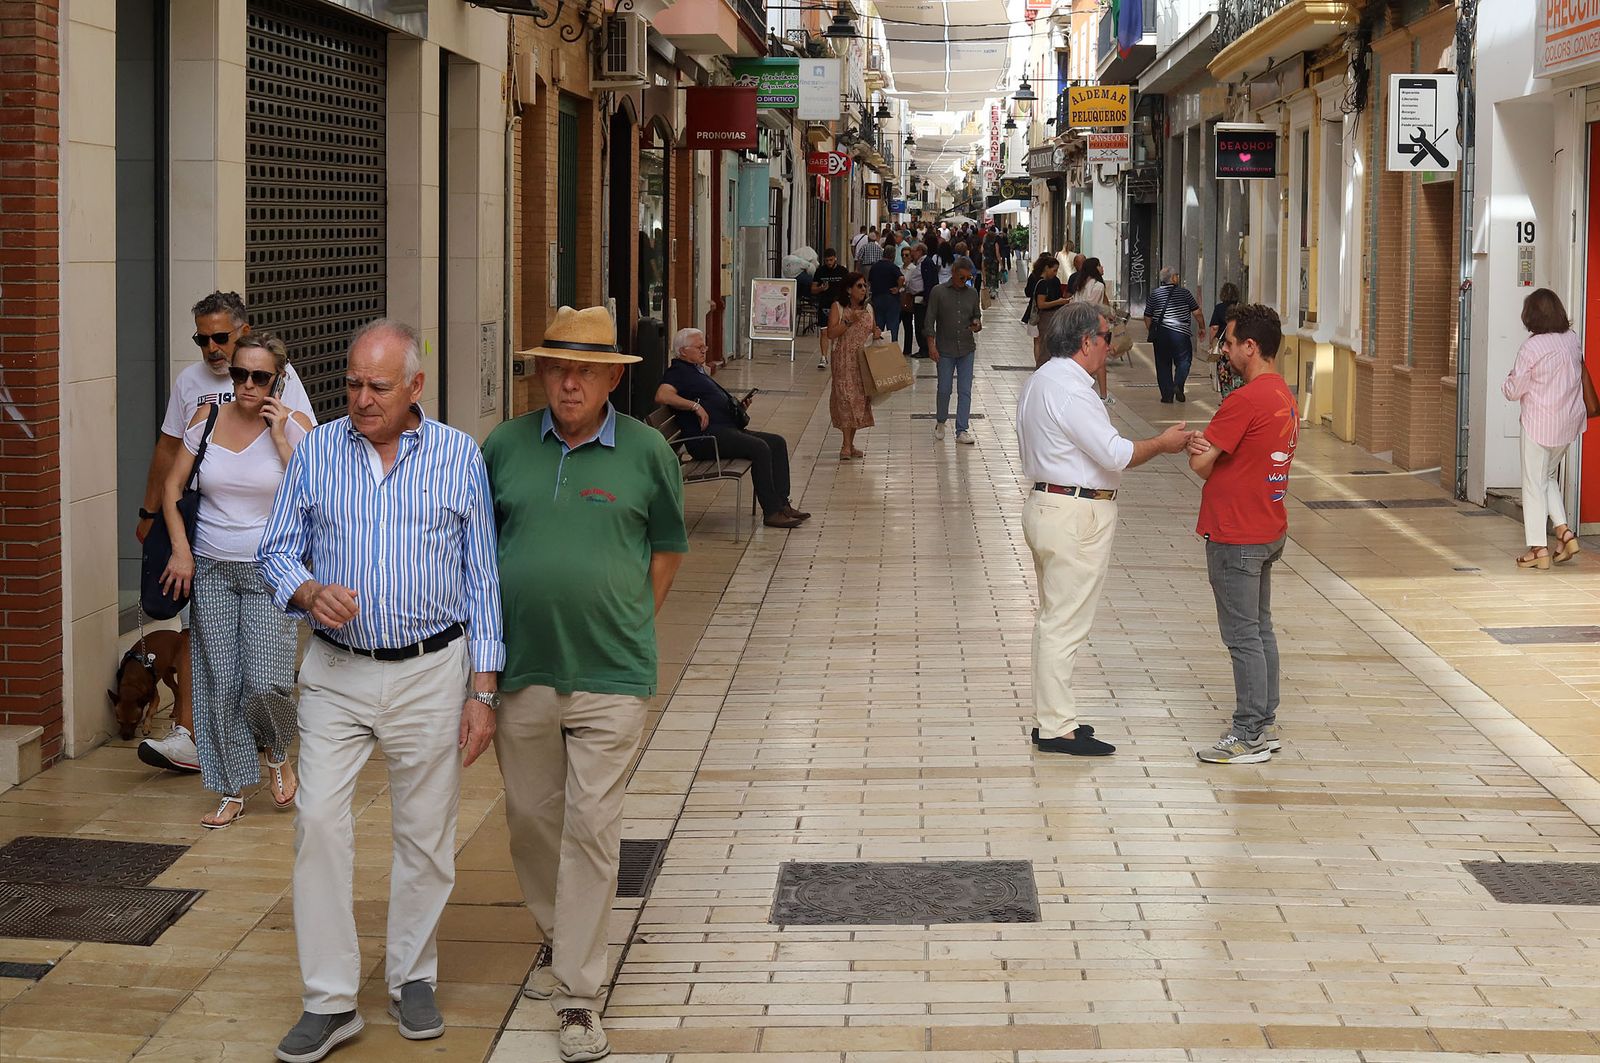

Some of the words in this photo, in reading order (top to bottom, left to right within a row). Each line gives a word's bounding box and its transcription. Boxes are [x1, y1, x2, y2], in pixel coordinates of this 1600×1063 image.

[1071, 88, 1127, 106] ALDEMAR
[1072, 110, 1127, 123] PELUQUEROS
[697, 131, 746, 140] PRONOVIAS
[981, 160, 1006, 170] CHINO
[1516, 221, 1535, 243] 19
